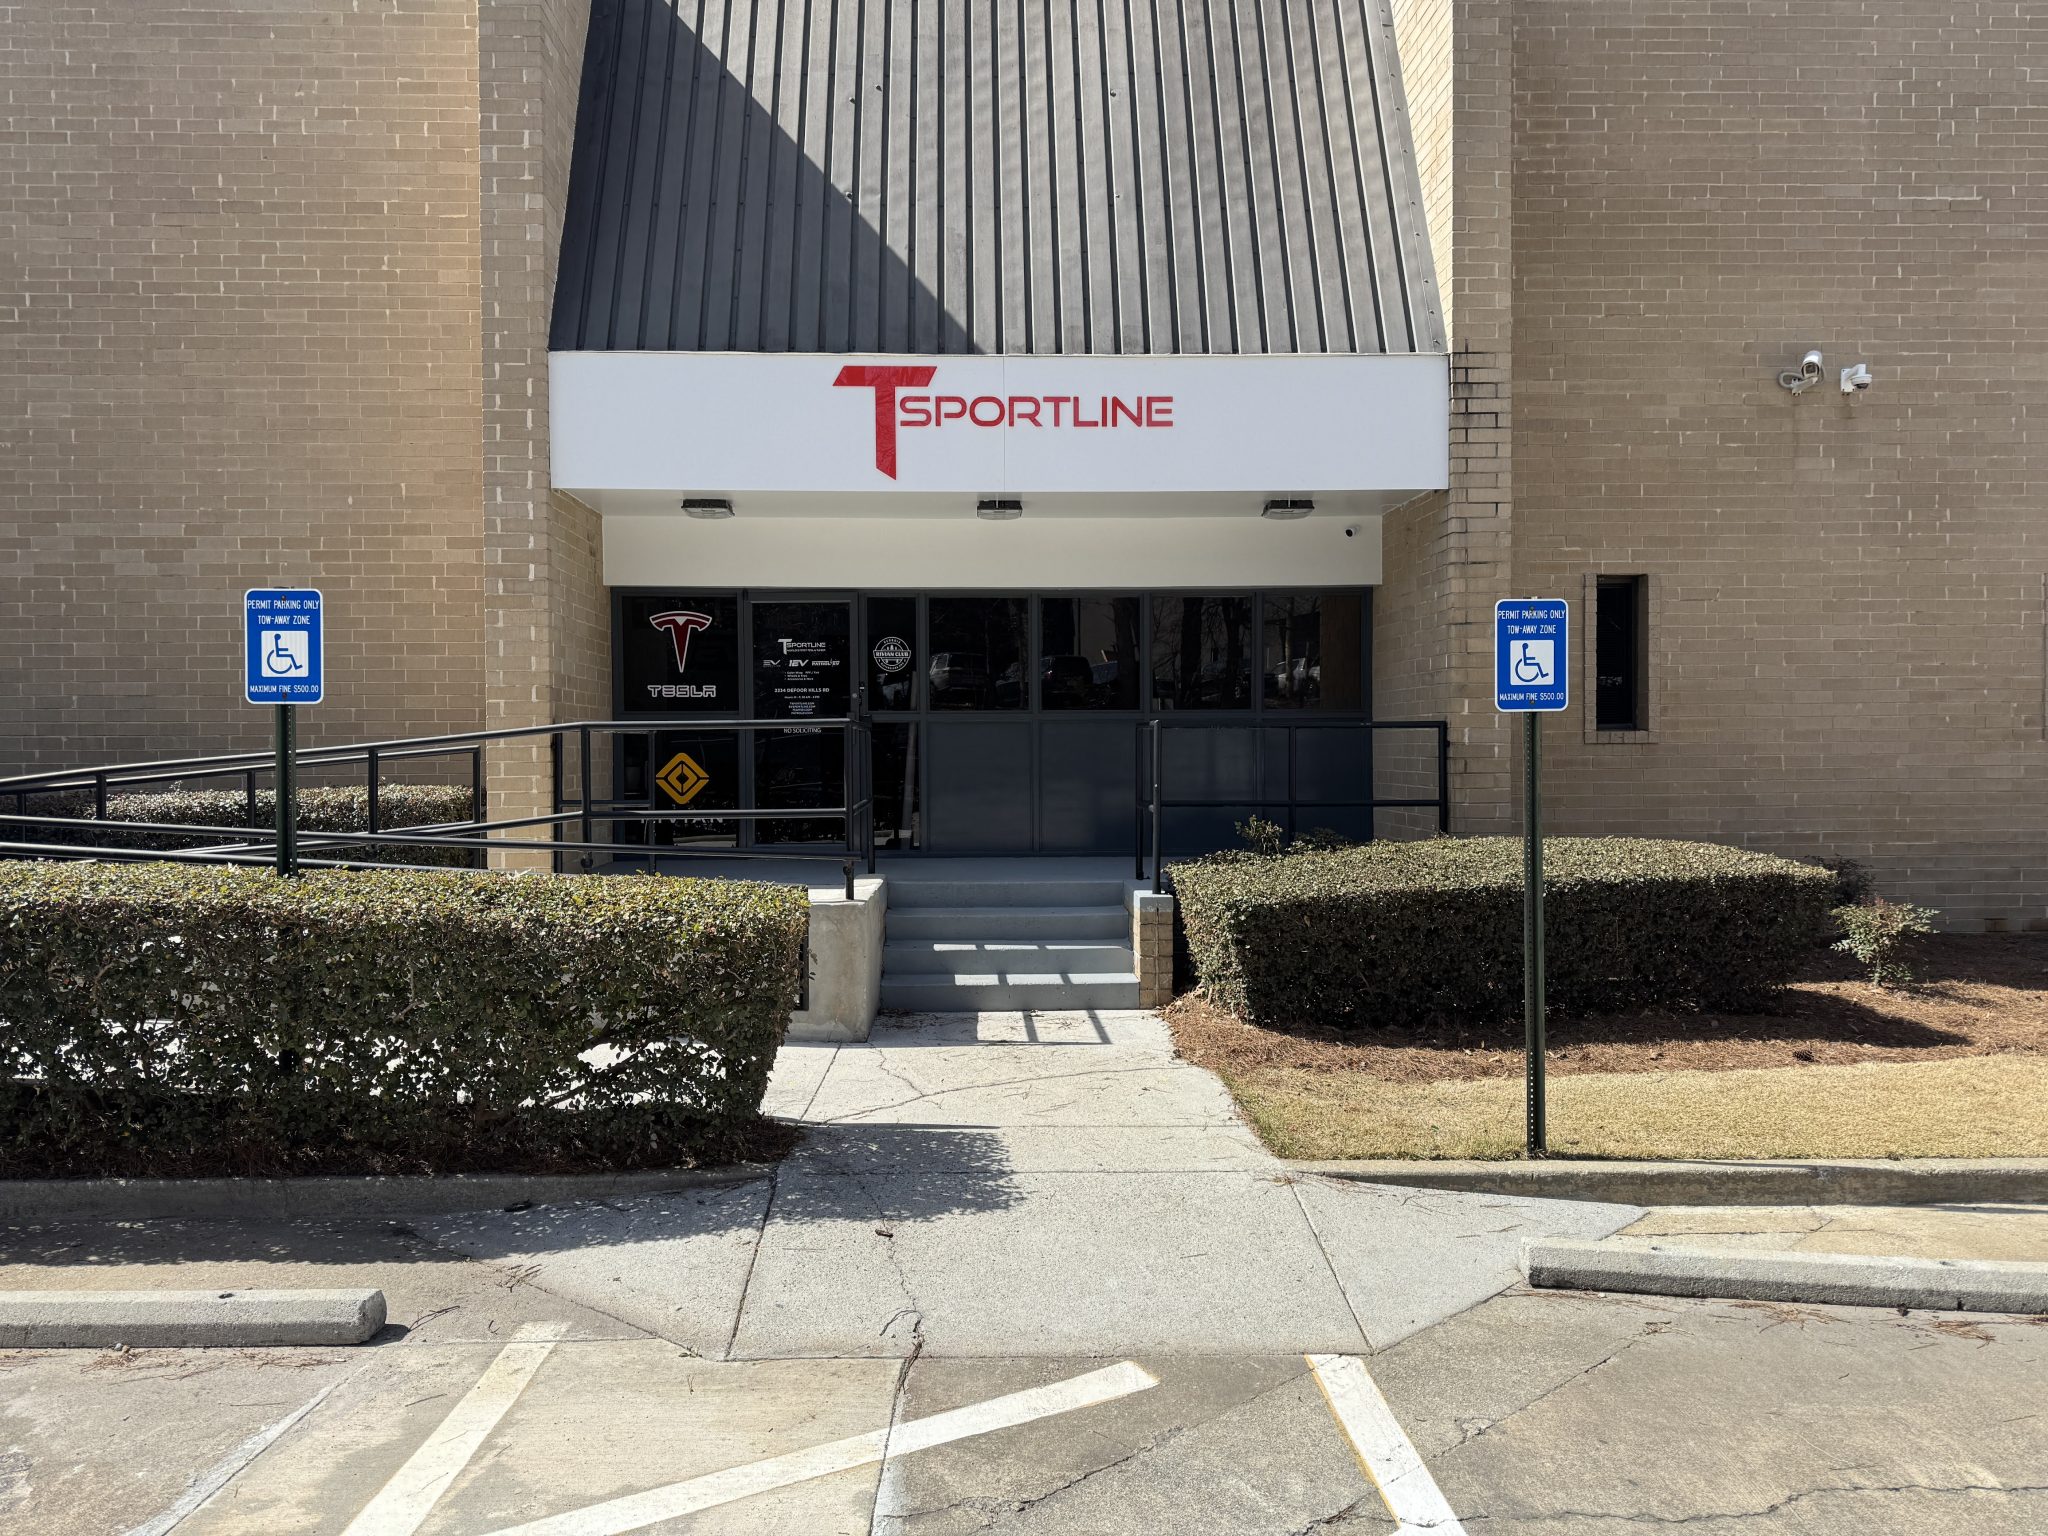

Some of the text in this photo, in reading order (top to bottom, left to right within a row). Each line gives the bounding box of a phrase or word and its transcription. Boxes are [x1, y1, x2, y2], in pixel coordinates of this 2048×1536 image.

[247, 600, 320, 610] PERMIT PARKING ONLY
[1498, 610, 1566, 619] PERMIT PARKING ONLY
[257, 615, 311, 625] TOW-AWAY ZONE
[1506, 625, 1557, 634] TOW-AWAY ZONE
[250, 685, 319, 693] MAXIMUM FINE $500.00
[647, 685, 717, 698] TESLA
[1499, 692, 1564, 701] MAXIMUM FINE $500.00
